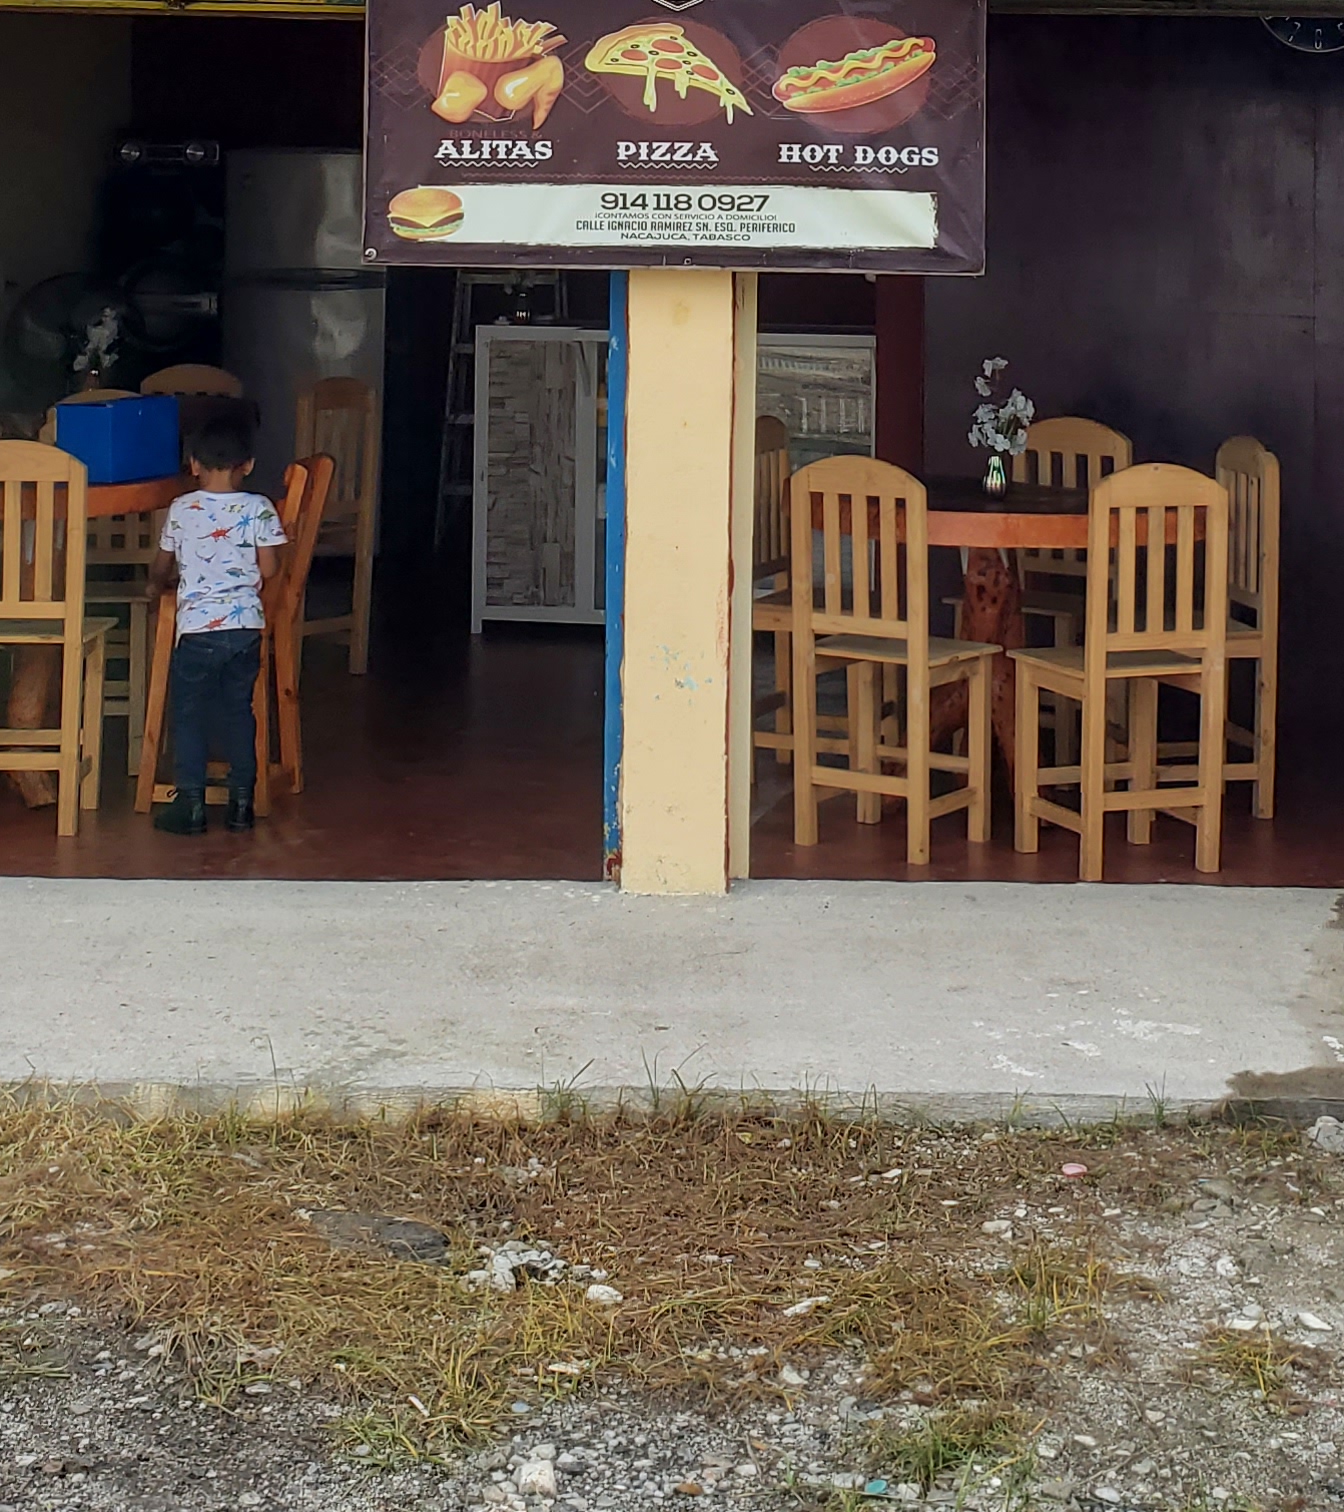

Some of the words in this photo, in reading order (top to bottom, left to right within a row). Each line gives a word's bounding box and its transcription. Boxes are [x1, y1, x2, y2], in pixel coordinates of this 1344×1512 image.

[449, 129, 528, 139] BONELESS
[434, 139, 554, 160] ALITAS
[616, 141, 720, 161] PIZZA
[777, 143, 844, 164] HOT
[854, 145, 940, 167] DOGS
[600, 192, 649, 211] 914
[652, 193, 693, 211] 118
[697, 193, 770, 212] 0927
[674, 213, 715, 221] SERVICIO
[576, 220, 605, 231] CALLE
[607, 220, 648, 231] IGNACIO
[650, 221, 693, 232] RAMIREZ
[695, 221, 712, 232] SN.
[714, 222, 737, 233] ESQ.
[739, 222, 796, 233] PERIFERICO
[621, 232, 691, 241] NACAJUCA,
[692, 233, 751, 241] TABASCO
